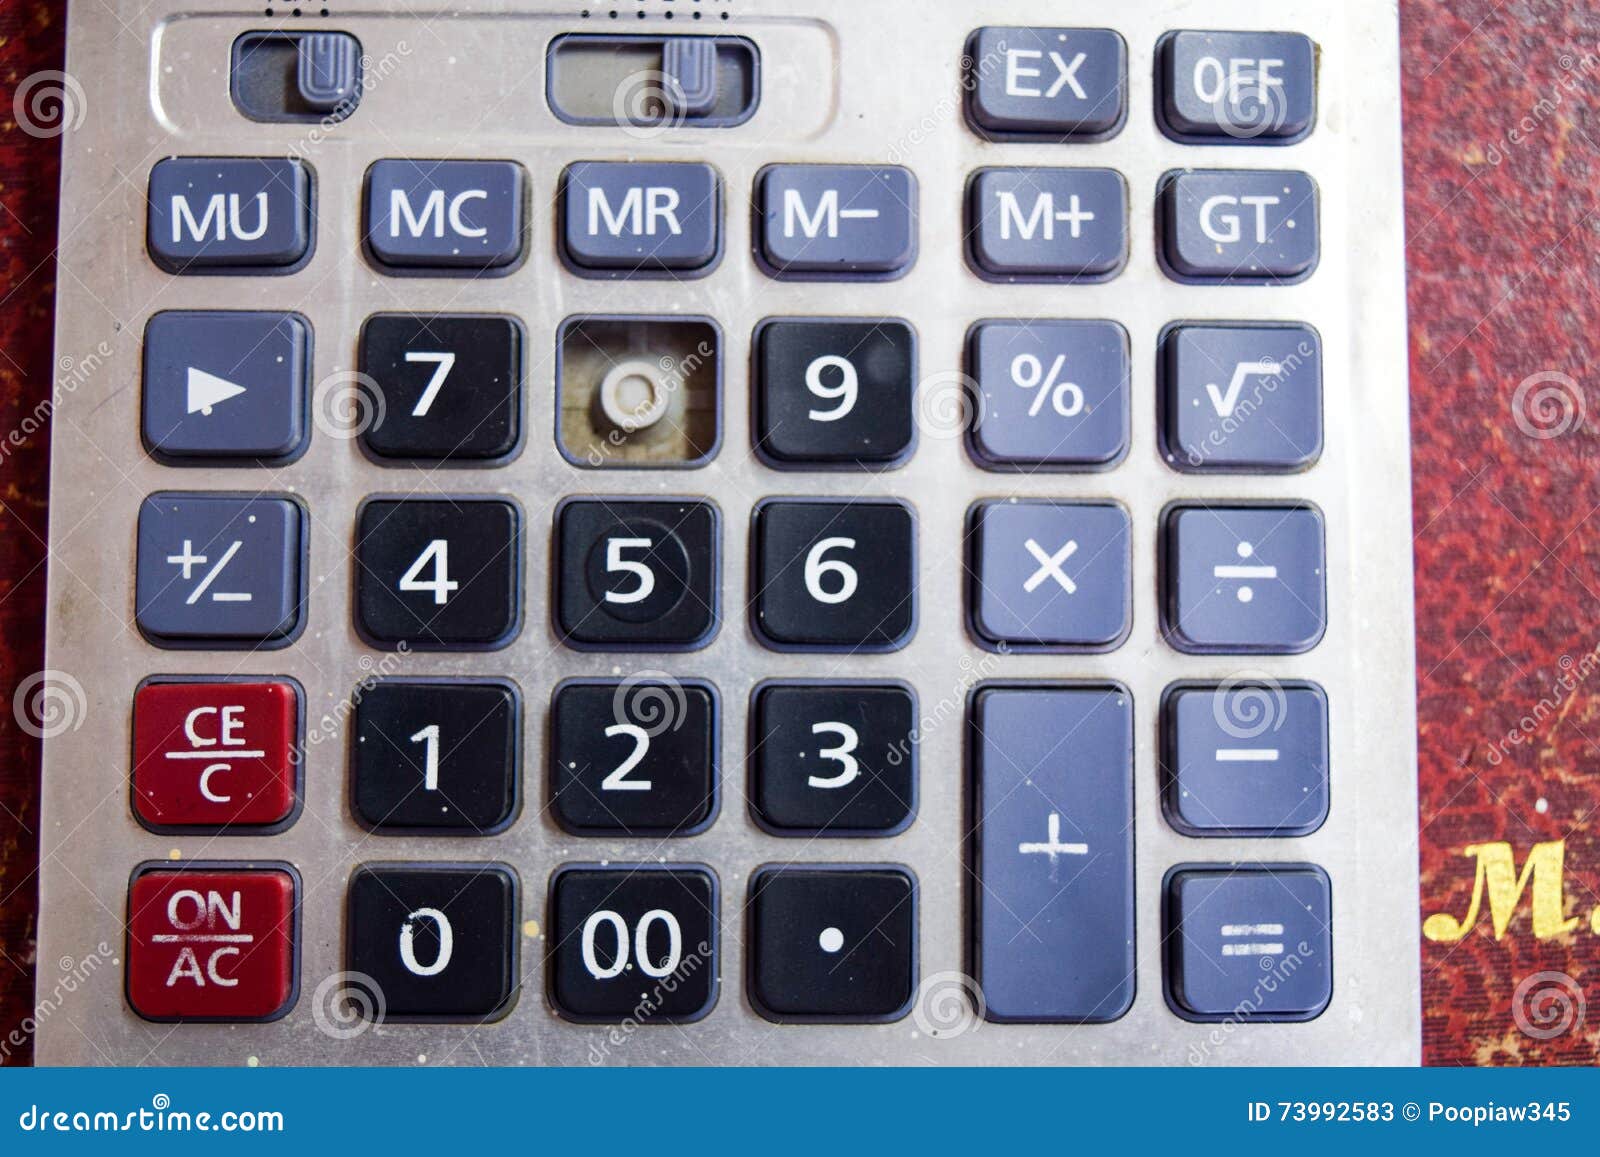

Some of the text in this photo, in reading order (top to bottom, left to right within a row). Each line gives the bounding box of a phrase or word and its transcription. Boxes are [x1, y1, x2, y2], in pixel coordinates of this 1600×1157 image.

[1006, 48, 1087, 99] EX
[1193, 56, 1284, 105] OFF
[171, 192, 269, 243] MU
[390, 189, 488, 238] MC
[588, 187, 682, 237] MR
[1000, 191, 1095, 240] M+
[1199, 194, 1280, 244] GT
[405, 352, 456, 417] 7
[805, 355, 859, 422] 9
[1010, 353, 1085, 418] %
[399, 539, 459, 605] 4
[604, 537, 655, 604] 5
[804, 537, 858, 604] 6
[184, 705, 246, 747] CE
[808, 721, 859, 789] 3
[199, 763, 232, 803] C
[410, 724, 440, 791] 1
[601, 723, 652, 791] 2
[167, 889, 241, 930] ON
[166, 946, 240, 987] AC
[399, 907, 454, 976] 0
[581, 909, 682, 979] 00
